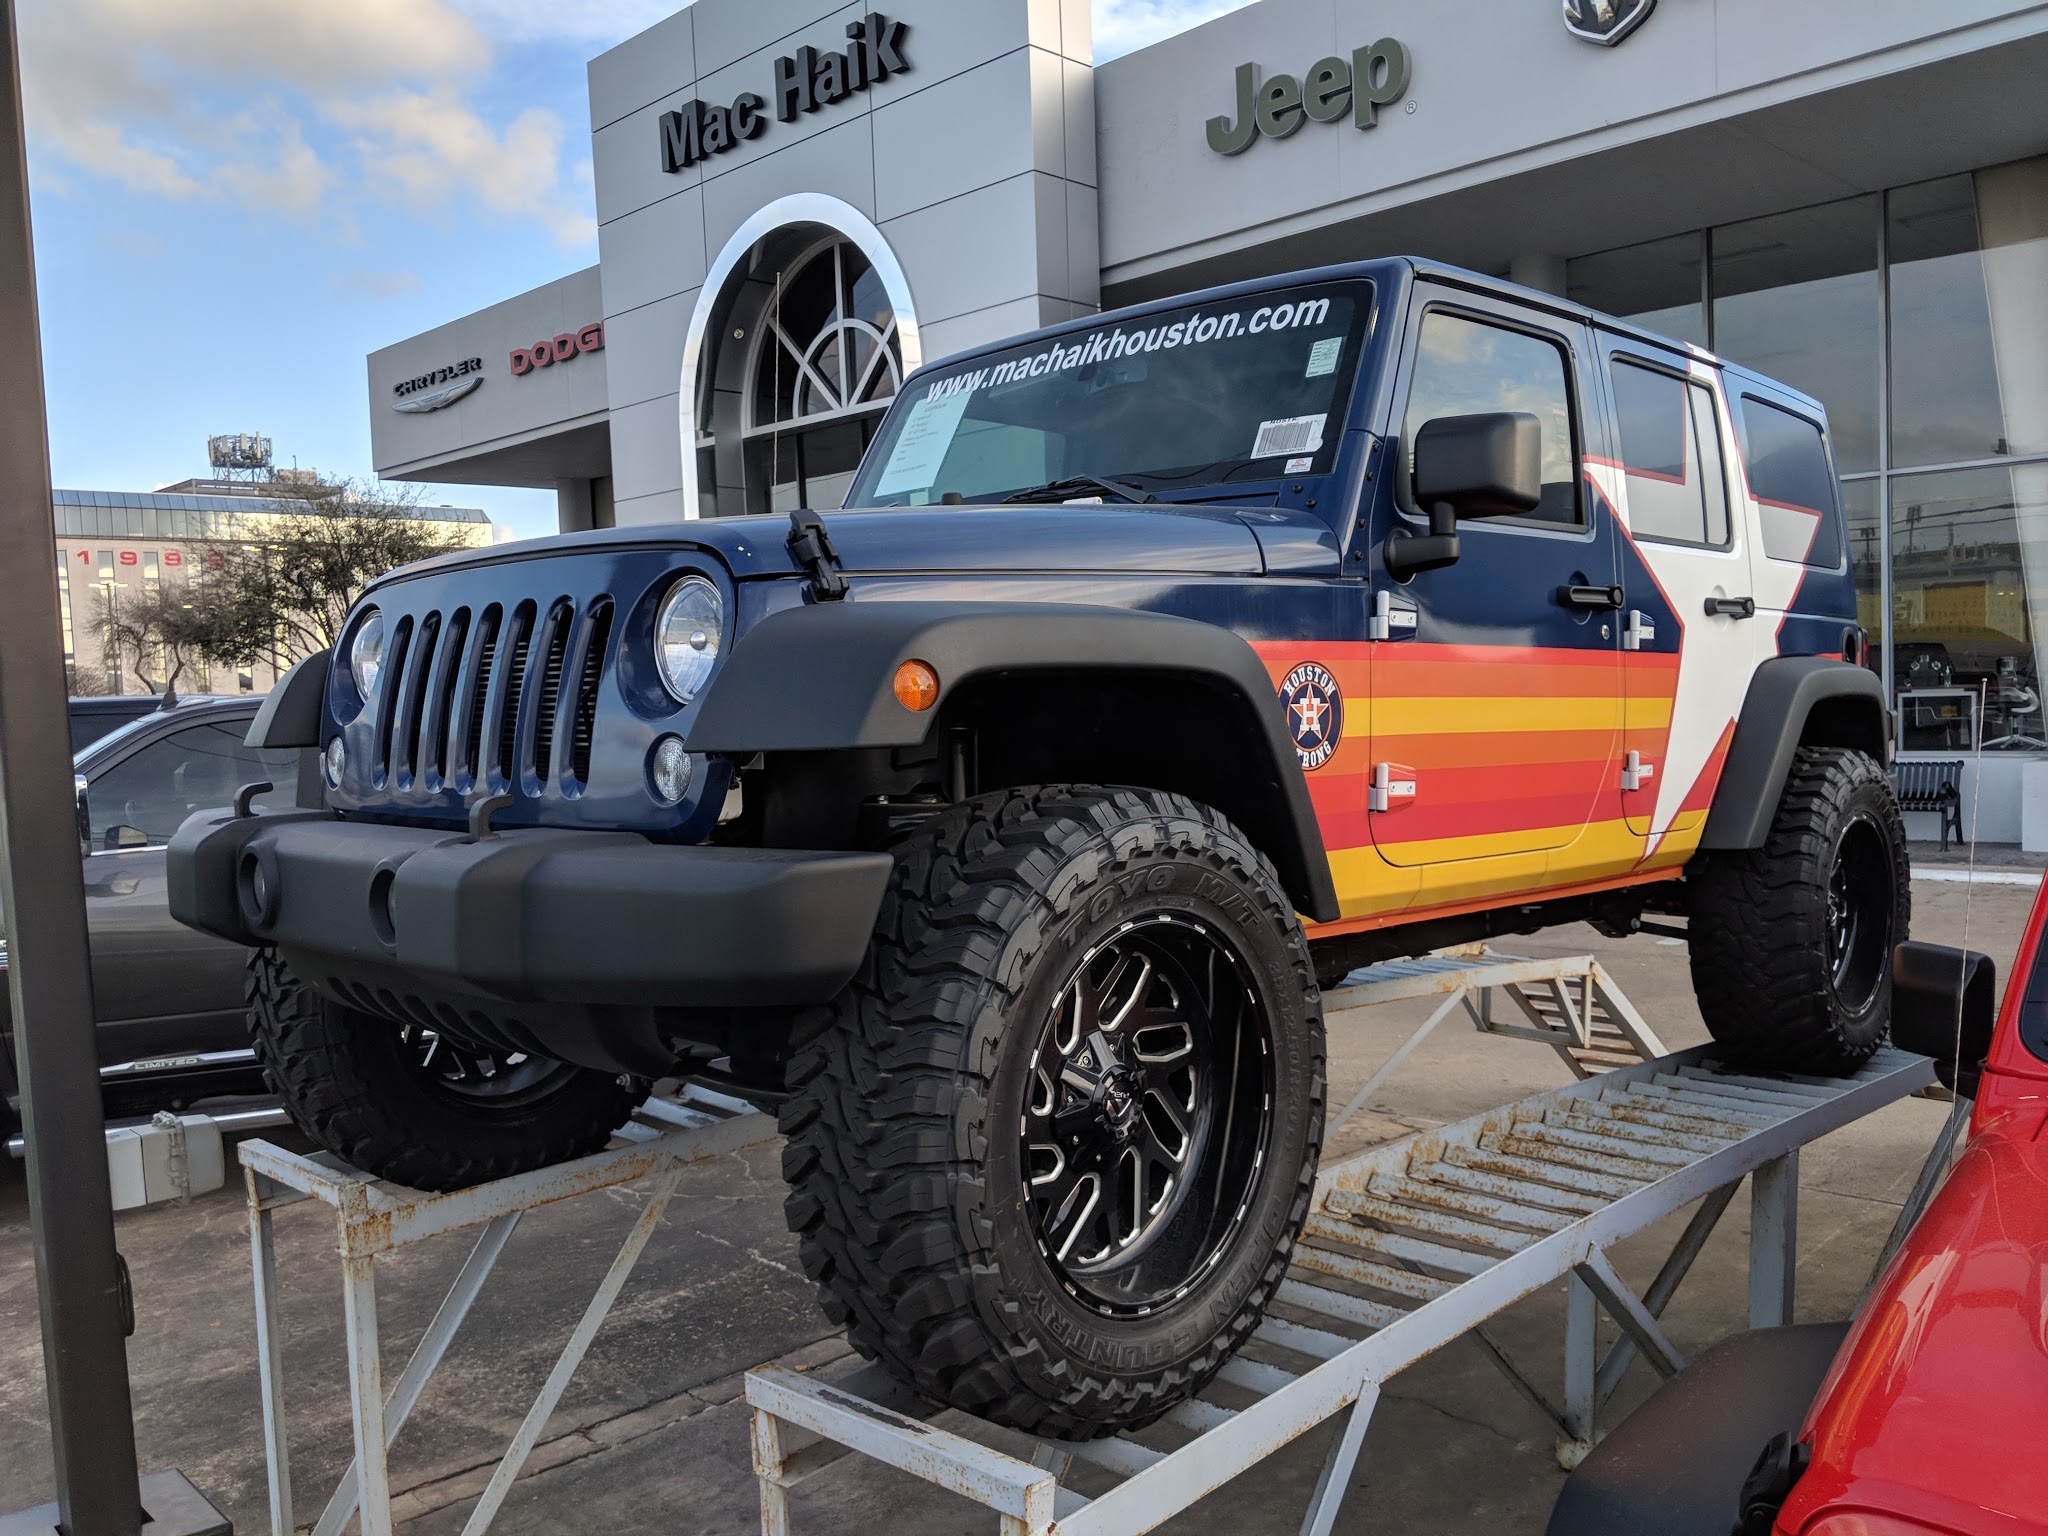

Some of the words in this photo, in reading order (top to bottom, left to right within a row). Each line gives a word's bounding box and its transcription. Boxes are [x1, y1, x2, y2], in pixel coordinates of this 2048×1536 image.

[659, 92, 765, 174] Mac
[774, 12, 911, 123] Haik
[1206, 37, 1412, 156] Jeep
[393, 357, 482, 396] CHRYSLER
[509, 321, 605, 376] DODG
[926, 297, 1330, 403] www.machaikhouston.com
[1283, 665, 1336, 697] HOUSTON
[1296, 740, 1332, 768] TRONG
[1058, 864, 1176, 949] TOYO
[134, 1057, 198, 1070] LIMITED
[1024, 1290, 1200, 1369] COUNTRY
